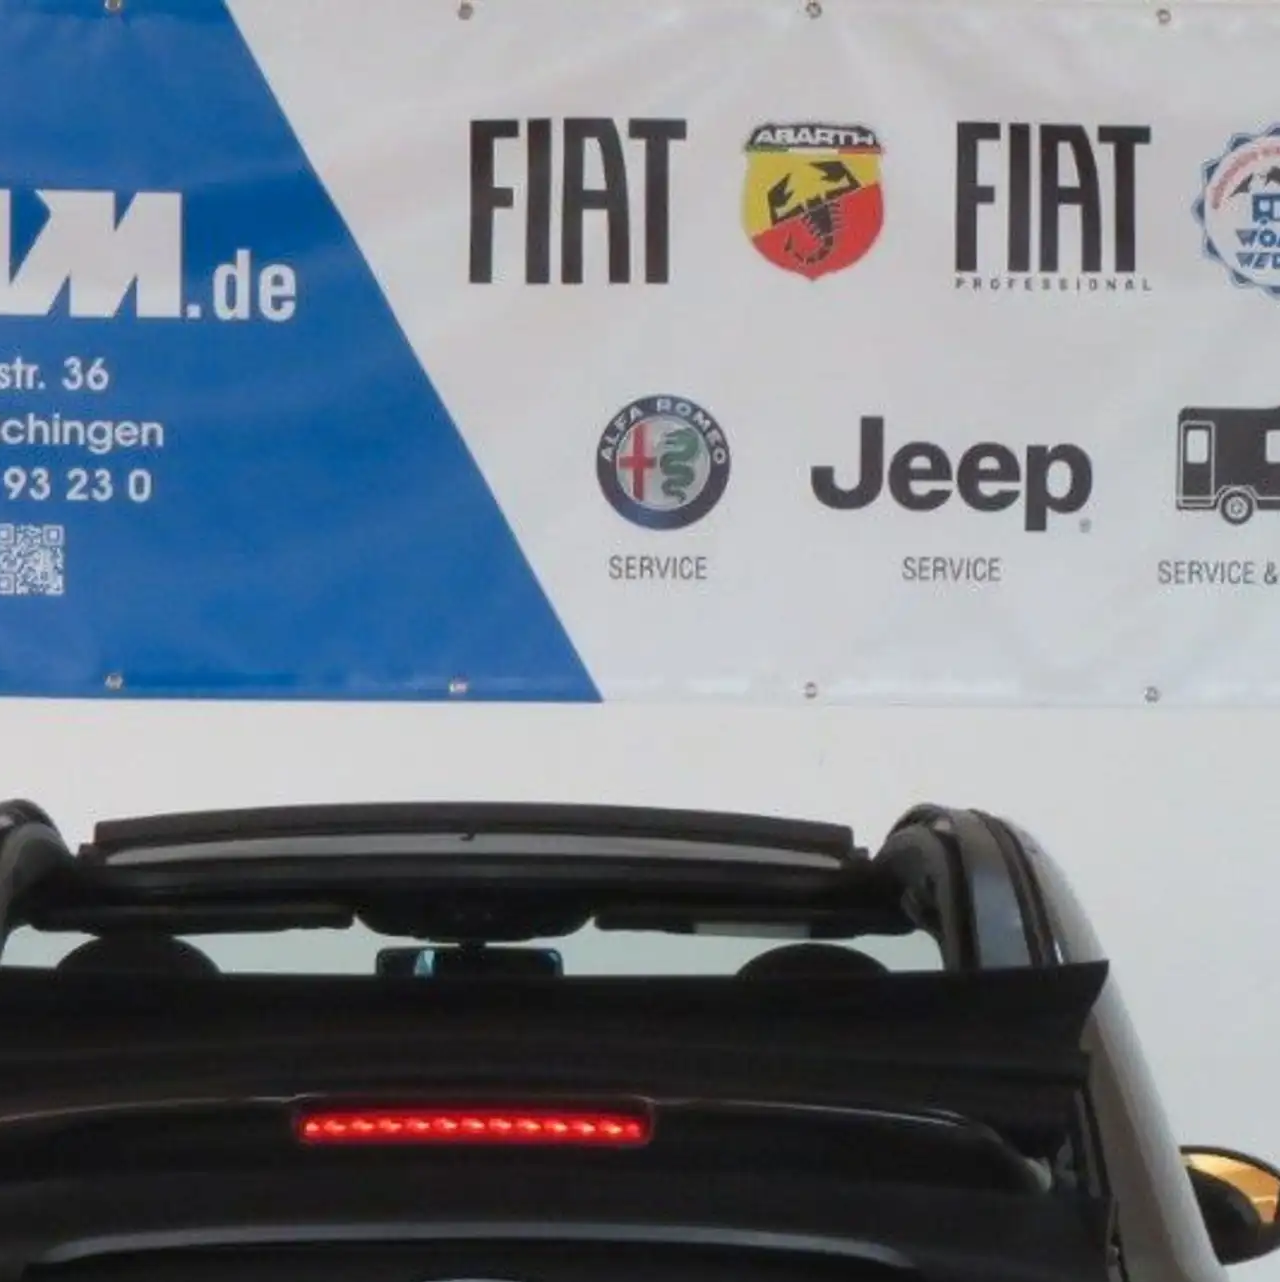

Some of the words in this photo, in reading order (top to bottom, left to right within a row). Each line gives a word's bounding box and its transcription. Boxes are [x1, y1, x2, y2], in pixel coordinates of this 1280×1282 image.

[755, 127, 874, 146] ABARTH
[469, 118, 687, 284] FIAT
[955, 121, 1151, 272] FIAT
[955, 278, 1152, 292] PROFESSIONAL
[61, 356, 109, 391] 36
[601, 405, 644, 462] ALFA
[656, 398, 726, 464] ROMEO
[3, 467, 52, 501] 93
[65, 468, 114, 502] 23
[127, 468, 153, 502] 0
[810, 415, 1093, 532] Jeep
[608, 555, 709, 581] SERVICE
[901, 556, 1001, 582] SERVICE
[1157, 560, 1256, 585] SERVICE
[1263, 561, 1279, 586] &
